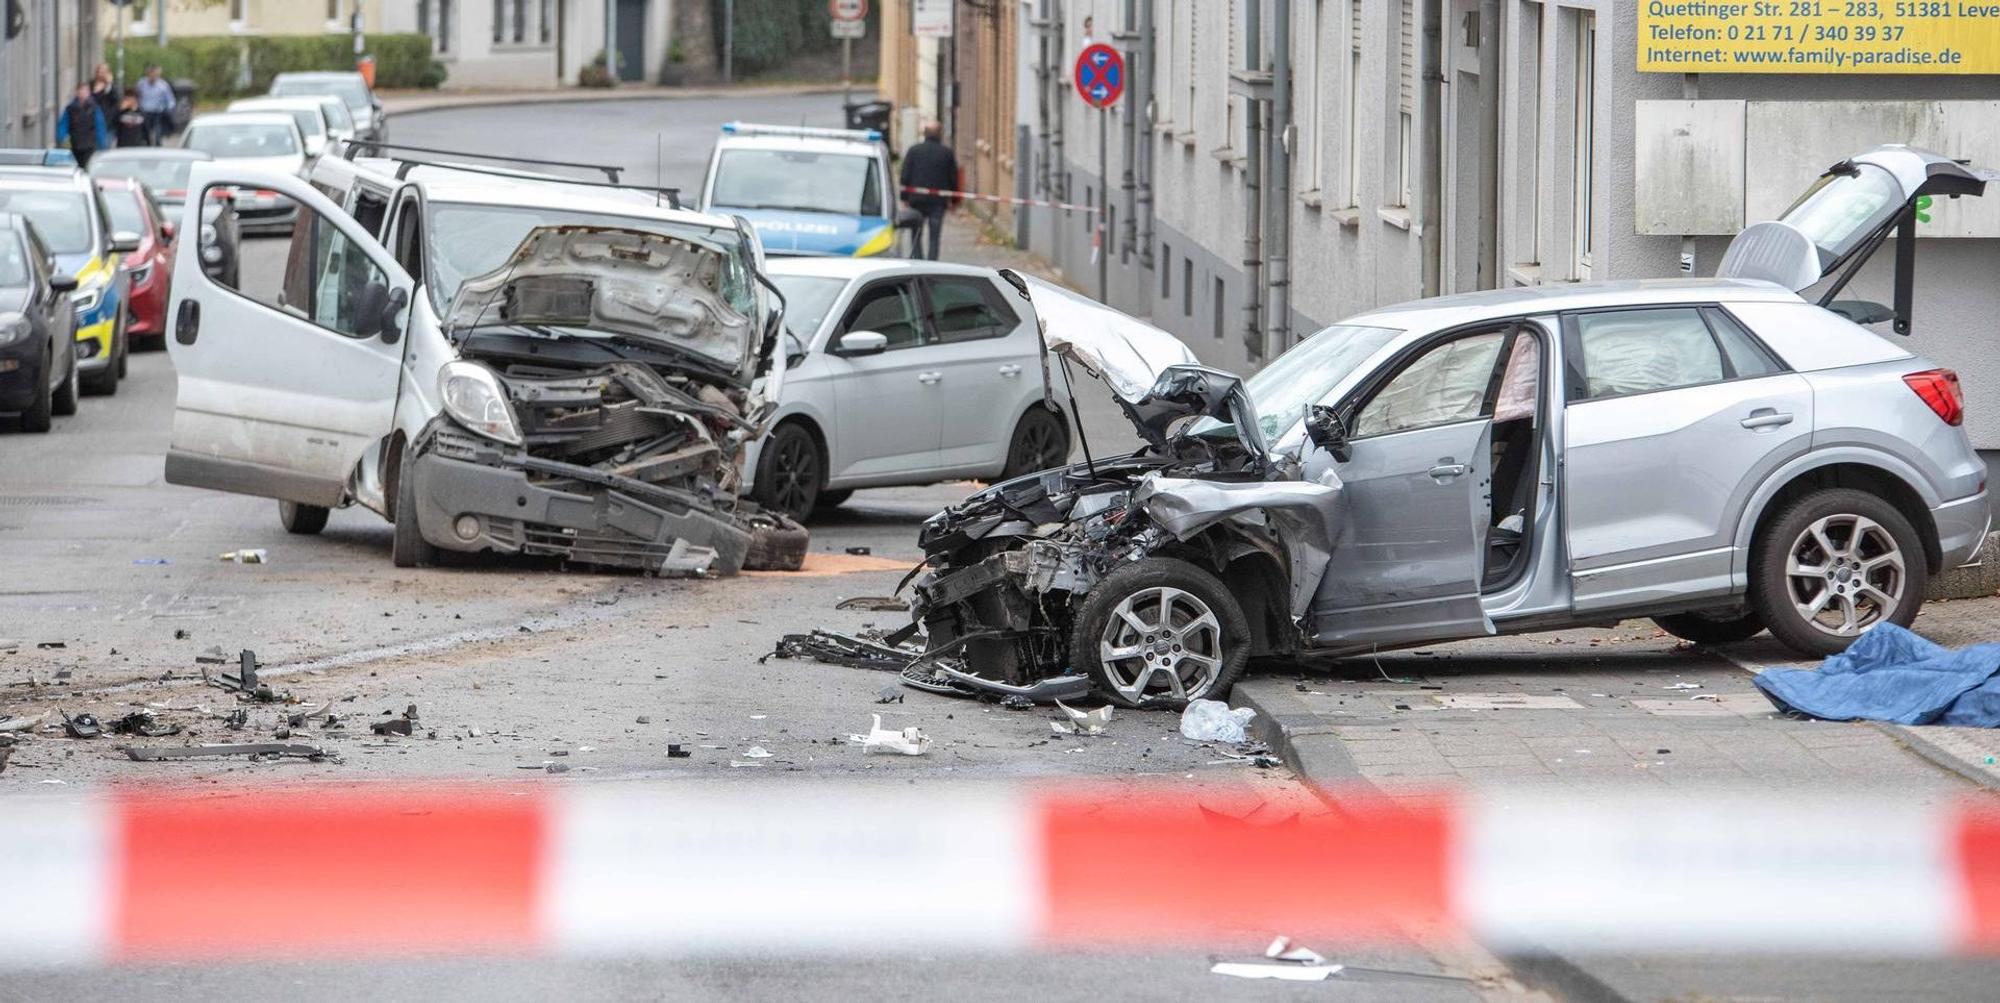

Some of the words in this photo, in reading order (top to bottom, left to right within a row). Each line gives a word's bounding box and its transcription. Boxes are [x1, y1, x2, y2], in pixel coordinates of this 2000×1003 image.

[1649, 1, 1748, 20] Quettinger
[1754, 1, 1782, 17] Str.
[1789, 2, 1822, 17] 281
[1845, 2, 1884, 20] 283,
[1896, 2, 1951, 17] 51381
[1958, 2, 2000, 17] Leve
[1649, 25, 1722, 40] Telefon:
[1728, 25, 1739, 41] 0
[1744, 25, 1766, 41] 21
[1772, 26, 1793, 41] 71
[1799, 24, 1809, 44] /
[1815, 26, 1848, 41] 340
[1854, 26, 1876, 41] 39
[1882, 26, 1905, 41] 37
[1647, 48, 1728, 63] Internet:
[1734, 47, 1962, 67] www.family-paradise.de
